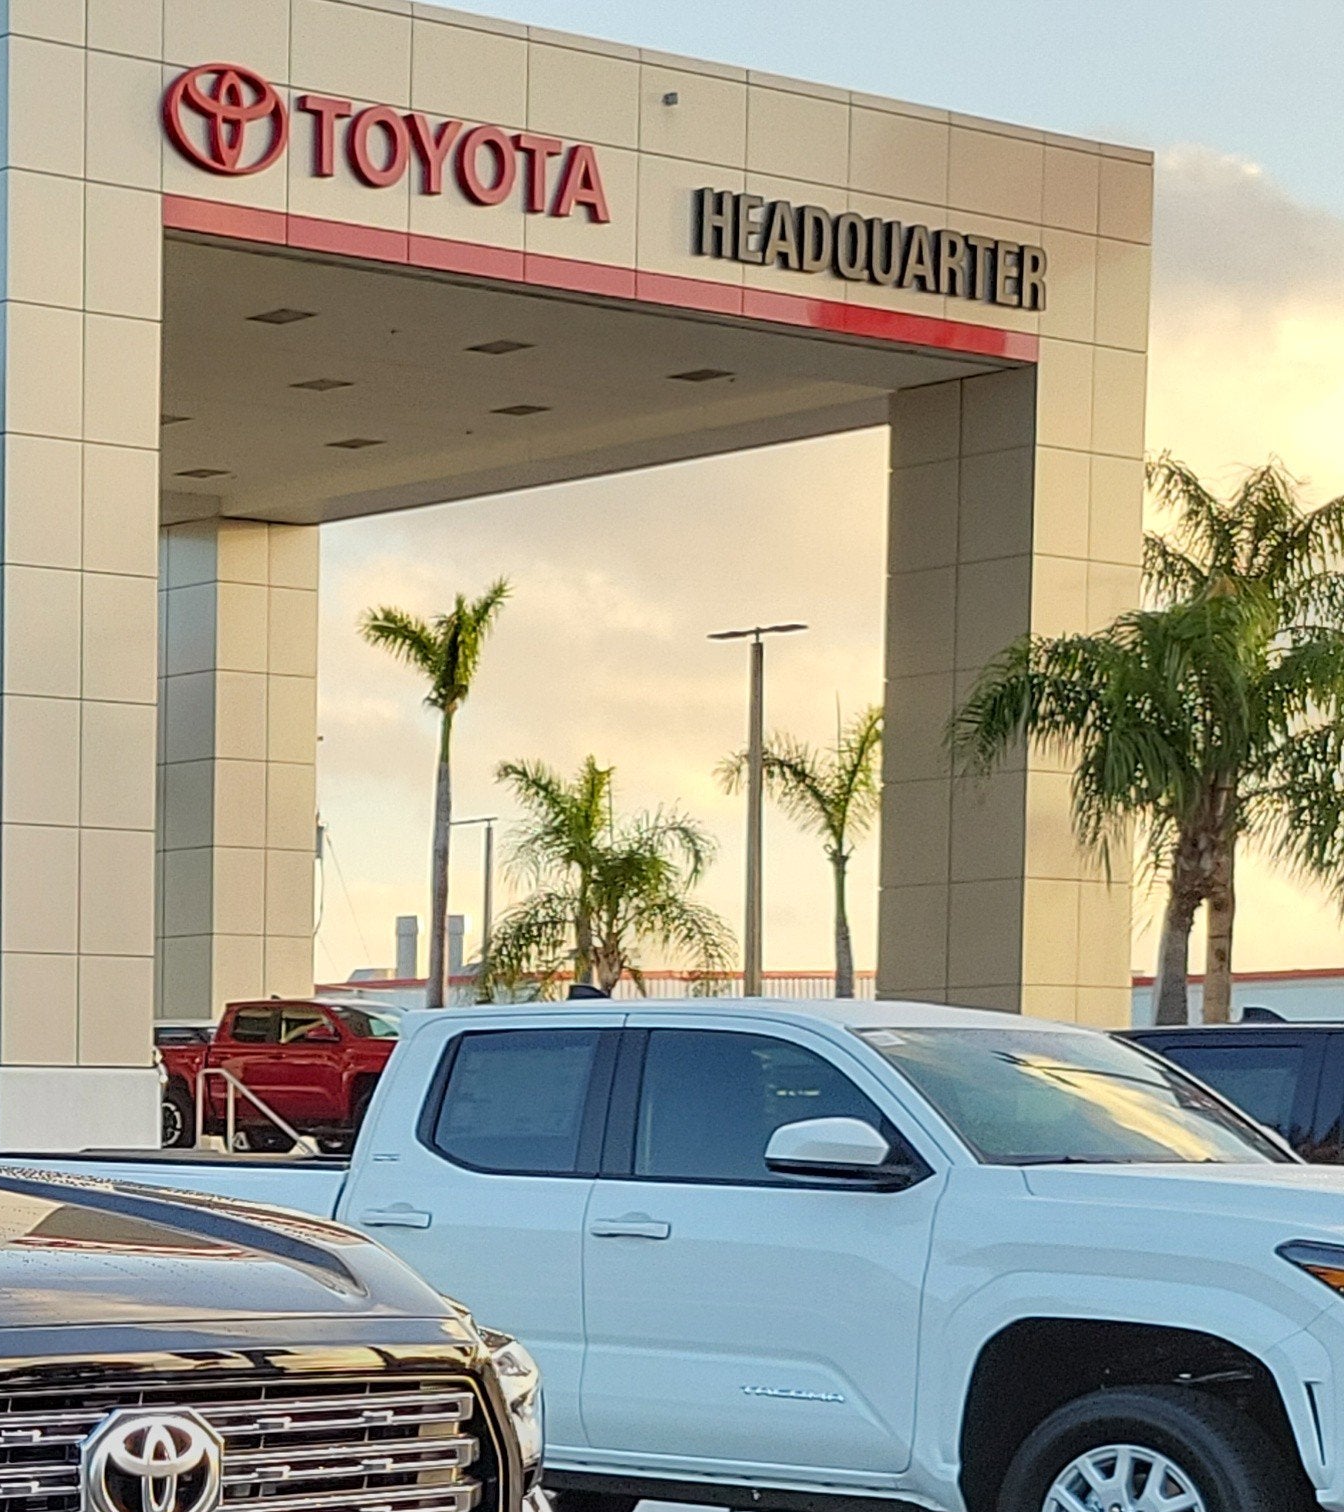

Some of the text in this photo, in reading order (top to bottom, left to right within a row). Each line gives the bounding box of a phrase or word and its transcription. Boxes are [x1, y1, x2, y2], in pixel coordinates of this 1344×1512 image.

[296, 94, 611, 224] TOYOTA
[691, 187, 1047, 311] HEADQUARTER
[740, 1386, 844, 1402] TACOMA
